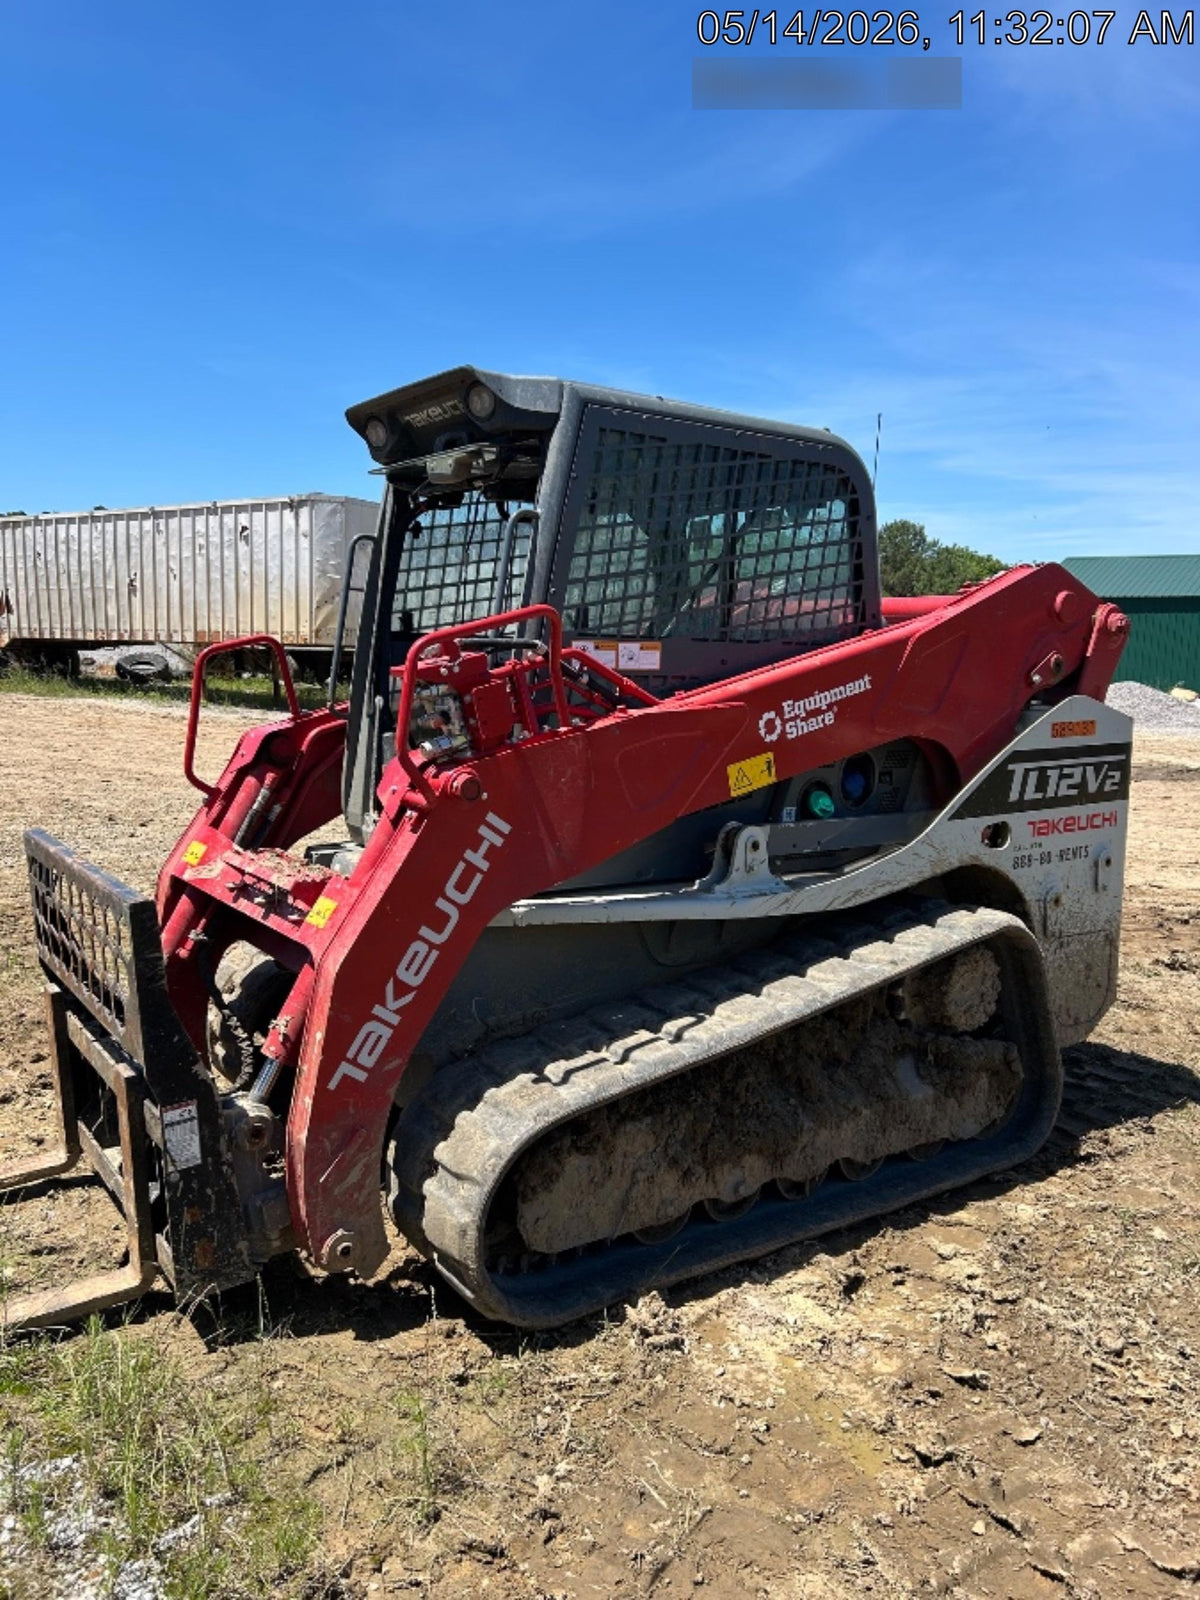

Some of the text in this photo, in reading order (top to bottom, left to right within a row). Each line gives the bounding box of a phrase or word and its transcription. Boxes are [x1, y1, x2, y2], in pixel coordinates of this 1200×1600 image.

[782, 673, 872, 719] Equipment
[785, 710, 835, 740] Share
[1027, 810, 1118, 838] TAKEUCHI
[327, 811, 512, 1090] TAKEUCHI
